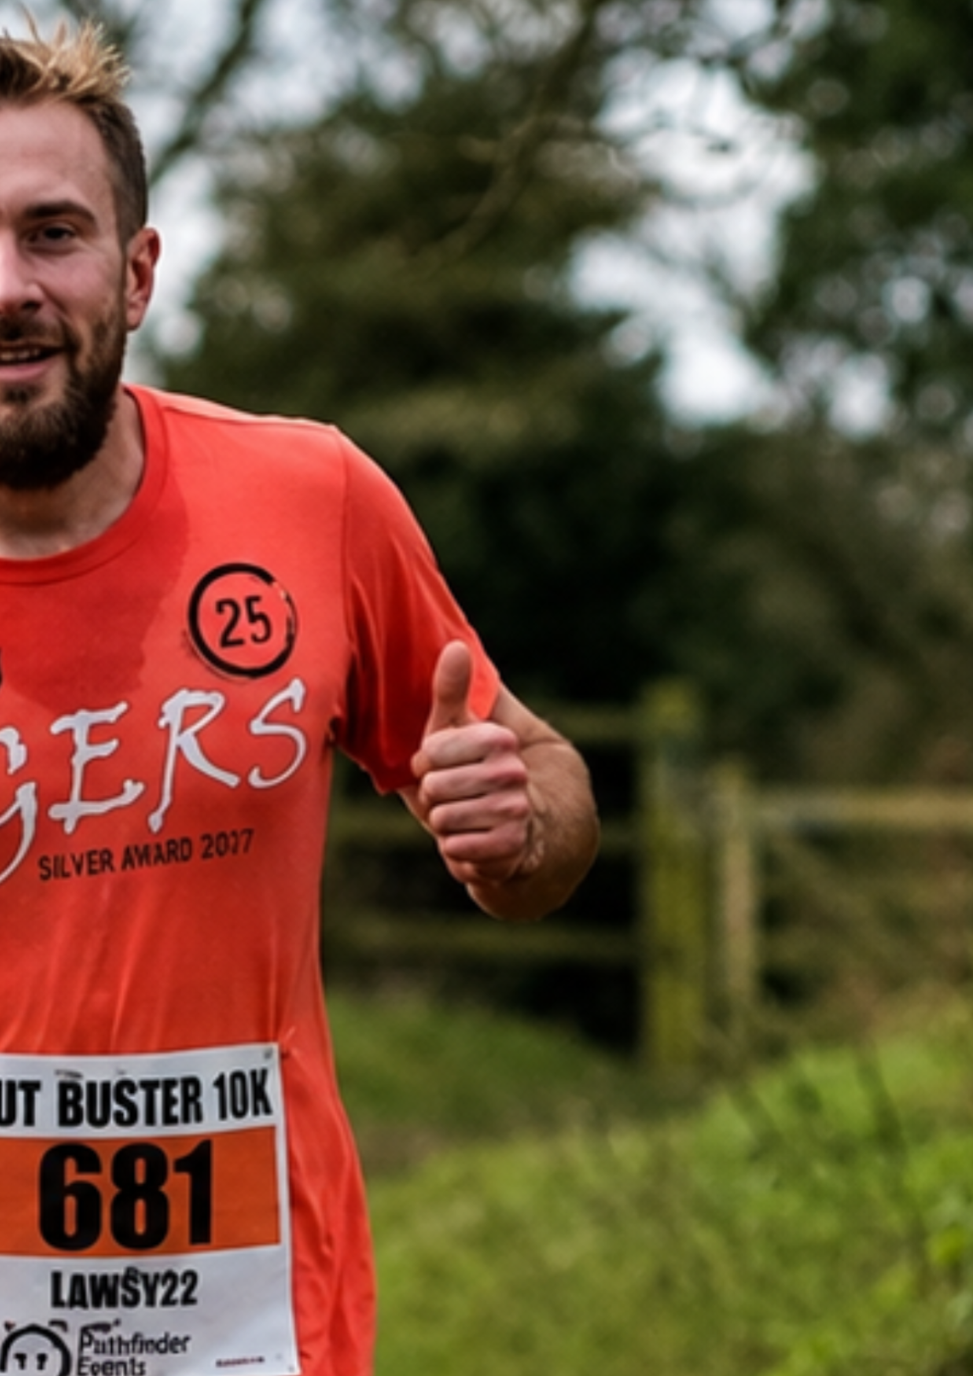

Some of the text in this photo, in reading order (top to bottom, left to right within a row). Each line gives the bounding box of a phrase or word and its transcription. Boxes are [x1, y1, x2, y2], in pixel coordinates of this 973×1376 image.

[216, 595, 272, 648] 25
[38, 848, 115, 881] SILVER
[121, 836, 193, 871] AWARD
[57, 1076, 204, 1128] BUSTER
[213, 1068, 273, 1121] 10K
[39, 1139, 213, 1250] 681
[50, 1267, 198, 1309] LAWSY22
